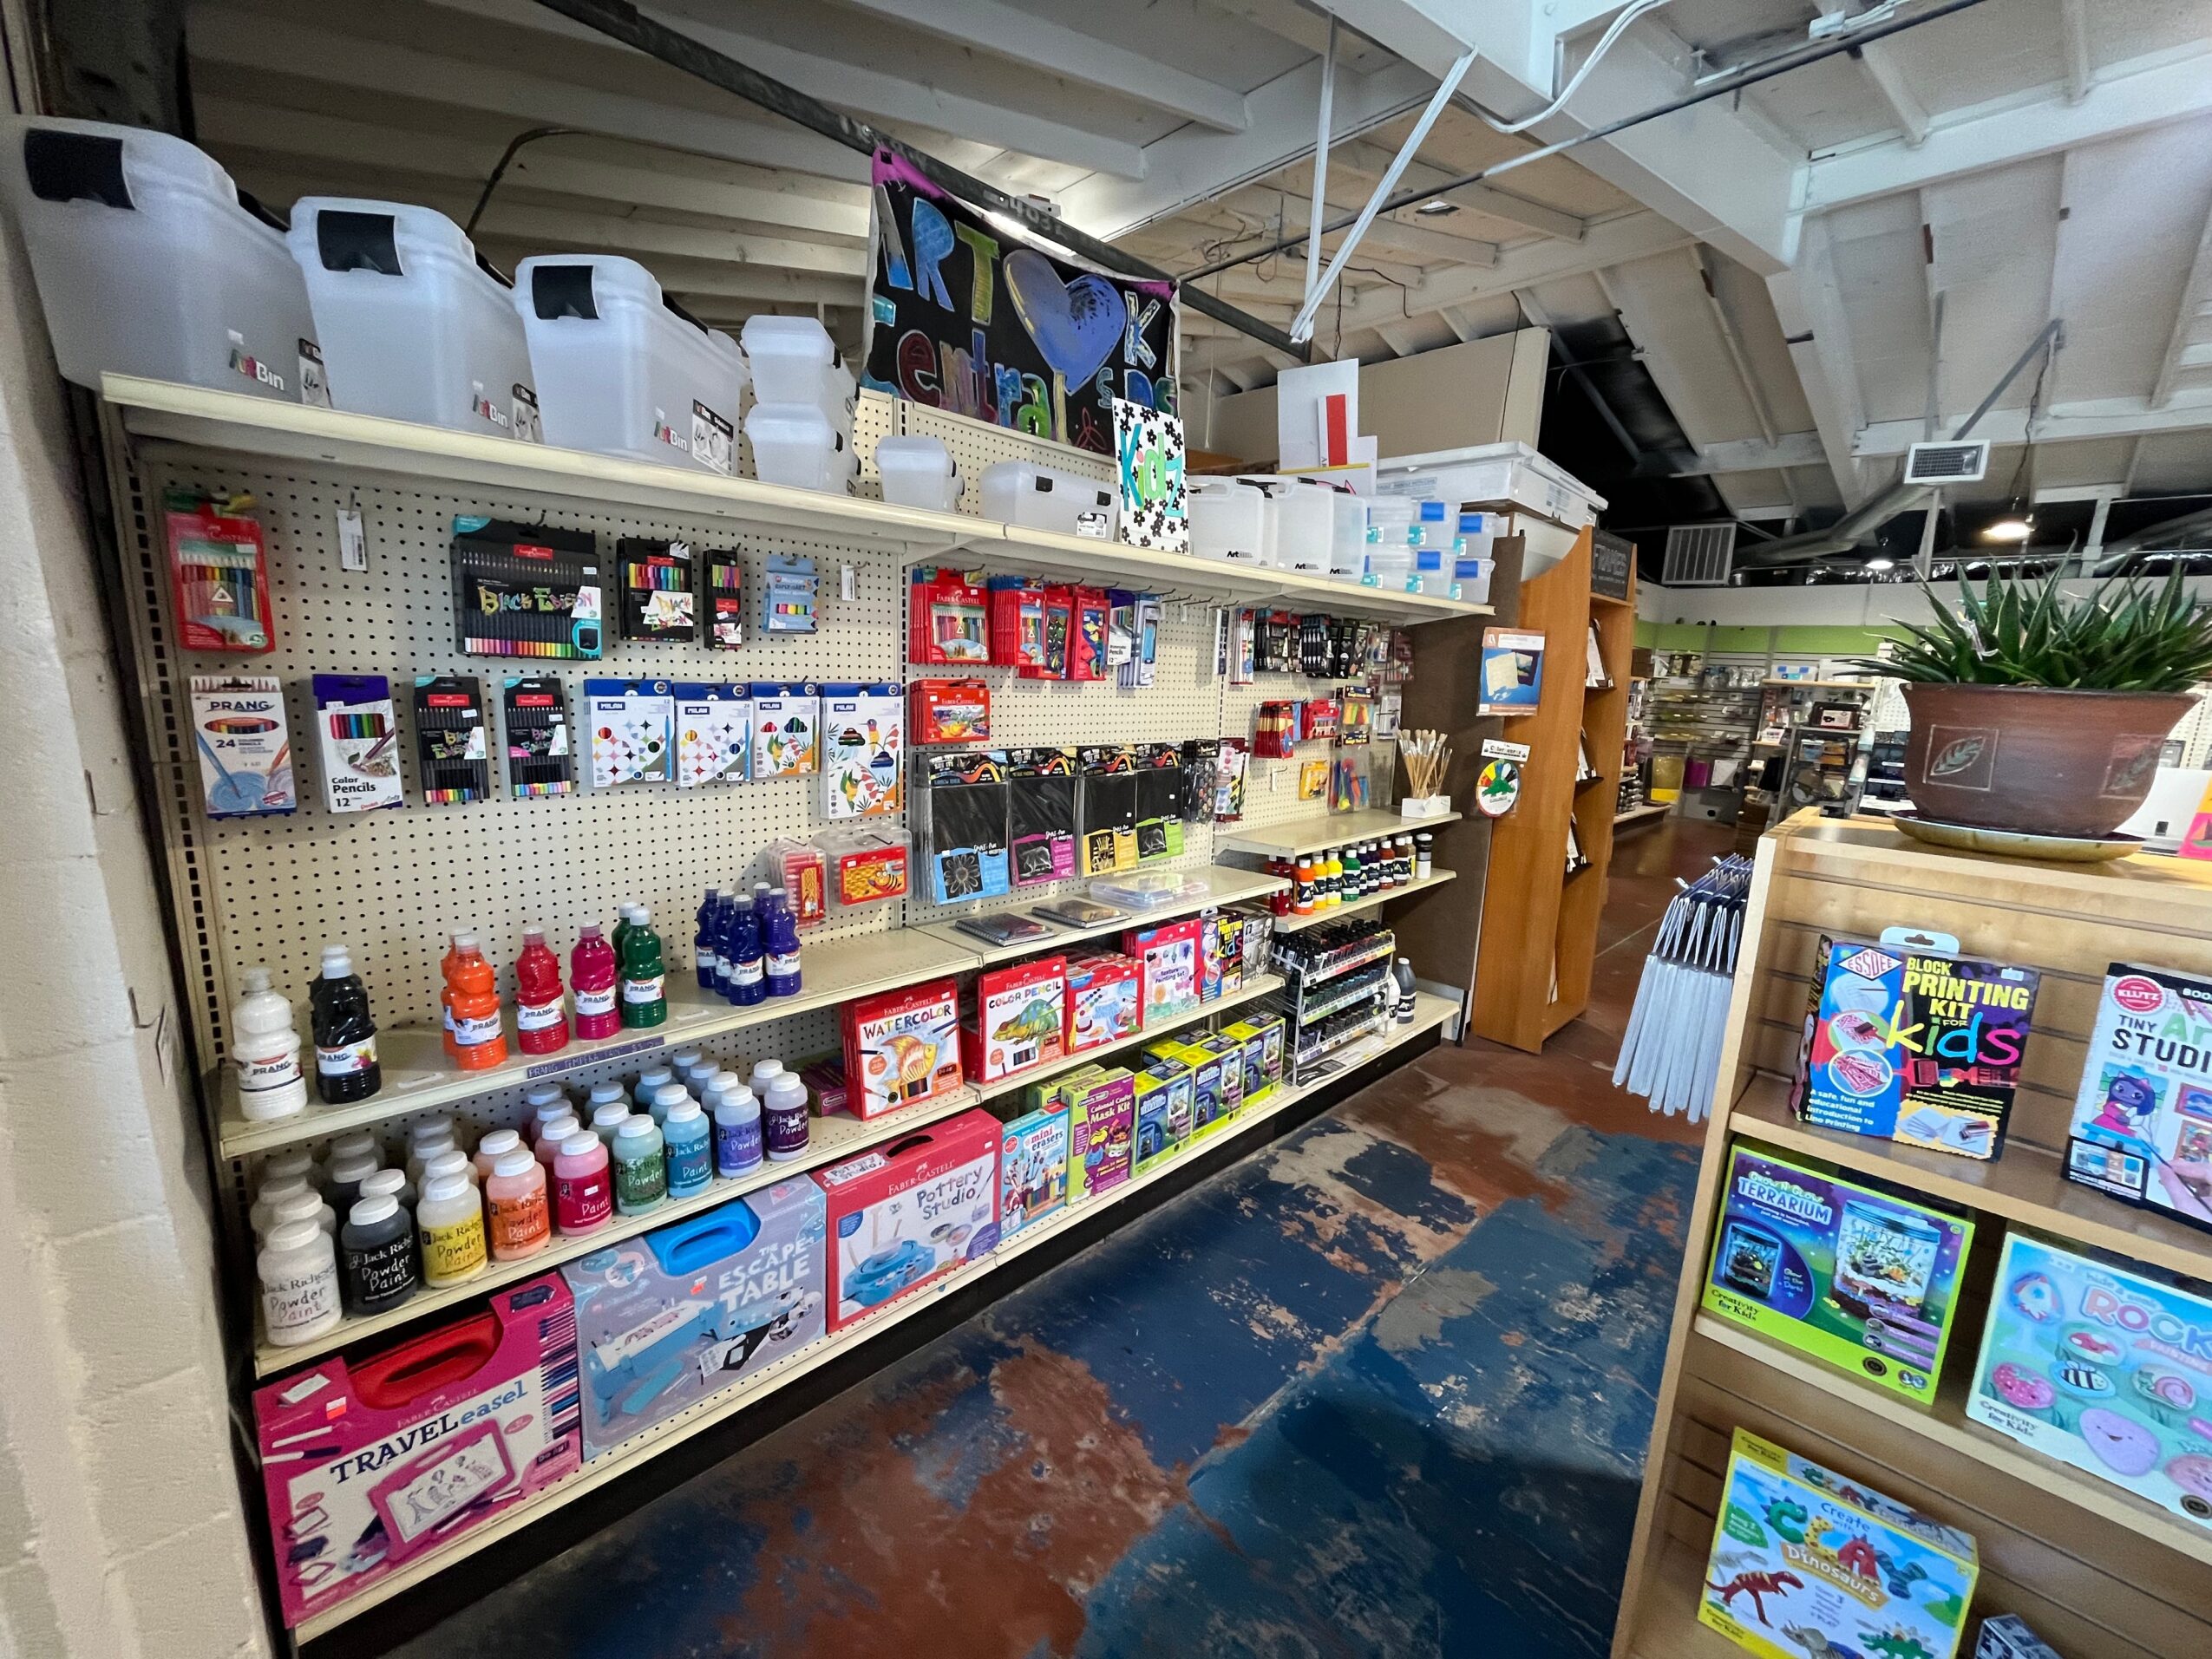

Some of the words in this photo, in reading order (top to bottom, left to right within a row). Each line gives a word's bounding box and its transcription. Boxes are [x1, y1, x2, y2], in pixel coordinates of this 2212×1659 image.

[872, 184, 999, 325] ART
[210, 701, 270, 710] PRANG
[216, 739, 235, 748] 24
[333, 782, 376, 794] Pencils
[336, 798, 350, 807] 12
[1216, 934, 1243, 958] kids
[1848, 950, 1893, 977] ESSDEE
[1908, 957, 1953, 976] BLOCK
[630, 983, 657, 992] PRANG
[1155, 975, 1176, 984] Painting
[989, 992, 1021, 1009] COLOR
[1024, 981, 1061, 997] PENCIL
[1902, 970, 2029, 1010] PRINTING
[2117, 989, 2160, 1000] KLUTZ
[525, 1008, 554, 1018] PRANG
[884, 997, 933, 1016] FABER-CASTELL
[1929, 998, 1974, 1018] KIT
[472, 1018, 499, 1031] PRANG
[863, 1004, 952, 1040] WATERCOLOR
[2118, 1014, 2157, 1033] TINY
[1886, 1000, 2021, 1065] kids
[253, 1061, 291, 1075] PRANG
[528, 1065, 558, 1078] PRANG
[1808, 1098, 1862, 1114] educational
[1840, 1094, 1857, 1104] fun
[1858, 1099, 1875, 1107] and
[1090, 1110, 1115, 1124] Mask
[1117, 1101, 1130, 1114] Kit
[1863, 1117, 1874, 1126] to
[780, 1120, 808, 1135] Powder
[1805, 1113, 1823, 1124] Lino
[1824, 1117, 1861, 1132] Printing
[730, 1134, 761, 1151] Powder
[1031, 1127, 1053, 1143] mini
[1031, 1131, 1063, 1152] erasers
[675, 1145, 692, 1156] Jack
[628, 1169, 663, 1186] Powder
[683, 1163, 707, 1179] Paint
[888, 1161, 954, 1195] FABER-CASTELL
[917, 1166, 982, 1208] Pottery
[582, 1196, 609, 1216] Paint
[923, 1187, 976, 1221] Studio
[1739, 1178, 1830, 1224] TERRARIUM
[433, 1231, 454, 1243] Jack
[508, 1223, 541, 1239] Paint
[437, 1233, 481, 1257] Powder
[759, 1243, 778, 1256] THE
[362, 1254, 409, 1281] Powder
[363, 1251, 387, 1265] Jack
[719, 1238, 808, 1290] ESCAPE
[370, 1268, 408, 1291] Paint
[719, 1254, 810, 1313] TABLE
[271, 1286, 324, 1310] Powder
[1711, 1289, 1758, 1314] Creativity
[278, 1303, 321, 1322] Paint
[1718, 1300, 1732, 1310] for
[1733, 1304, 1757, 1322] Kids
[2084, 1287, 2212, 1359] ROCK
[1980, 1401, 2039, 1430] Creativity
[1987, 1413, 2005, 1423] for
[2005, 1416, 2035, 1437] Kids
[1820, 1501, 1870, 1532] Create
[1832, 1519, 1855, 1532] with
[1787, 1545, 1879, 1603] Dinosaurs
